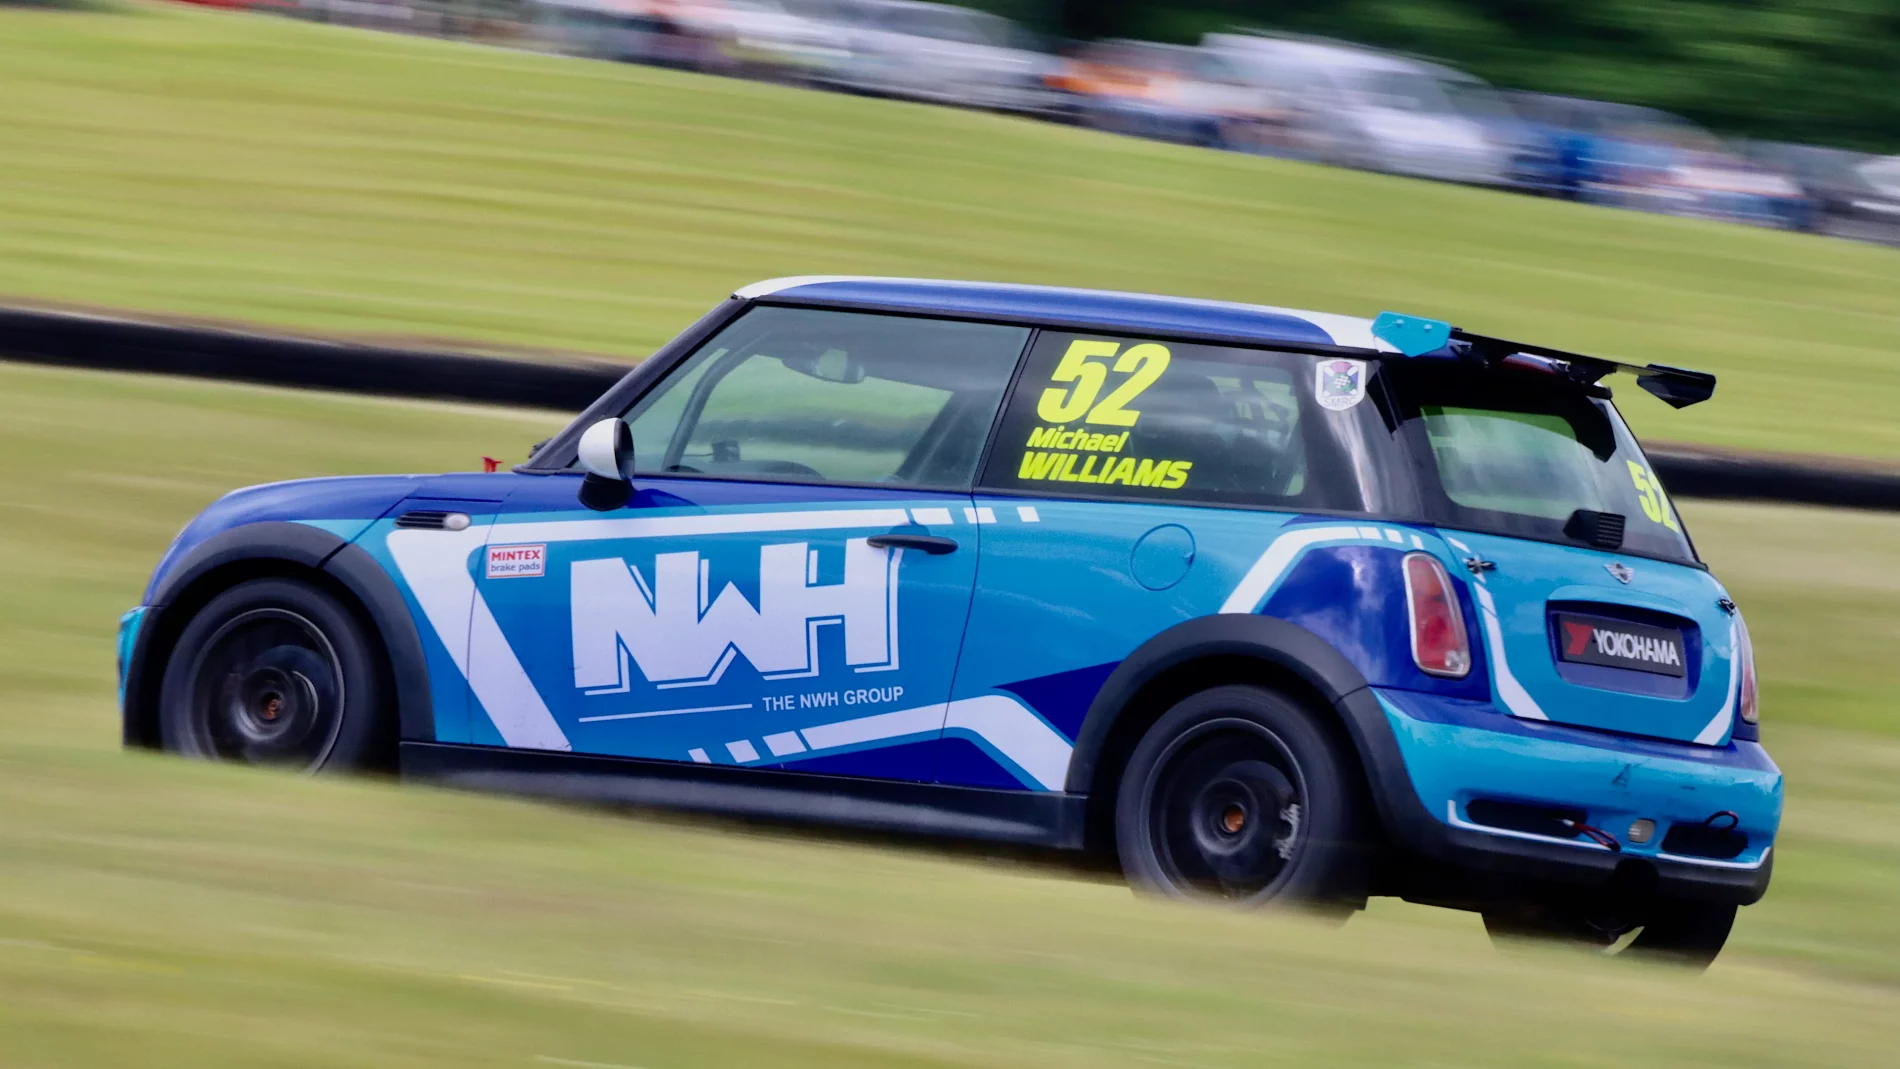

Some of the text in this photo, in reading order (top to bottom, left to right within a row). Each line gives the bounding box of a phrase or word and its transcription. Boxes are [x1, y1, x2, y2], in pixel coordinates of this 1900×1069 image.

[1037, 339, 1171, 427] 52
[1026, 425, 1130, 452] Michael
[1018, 451, 1193, 489] WILLIAMS
[1626, 460, 1680, 533] 52
[490, 561, 541, 573] brake pads
[491, 549, 541, 561] MINTEX
[570, 536, 900, 696] NWH
[1592, 628, 1681, 667] YOKOHAMA
[762, 686, 904, 712] THE NWH GROUP
